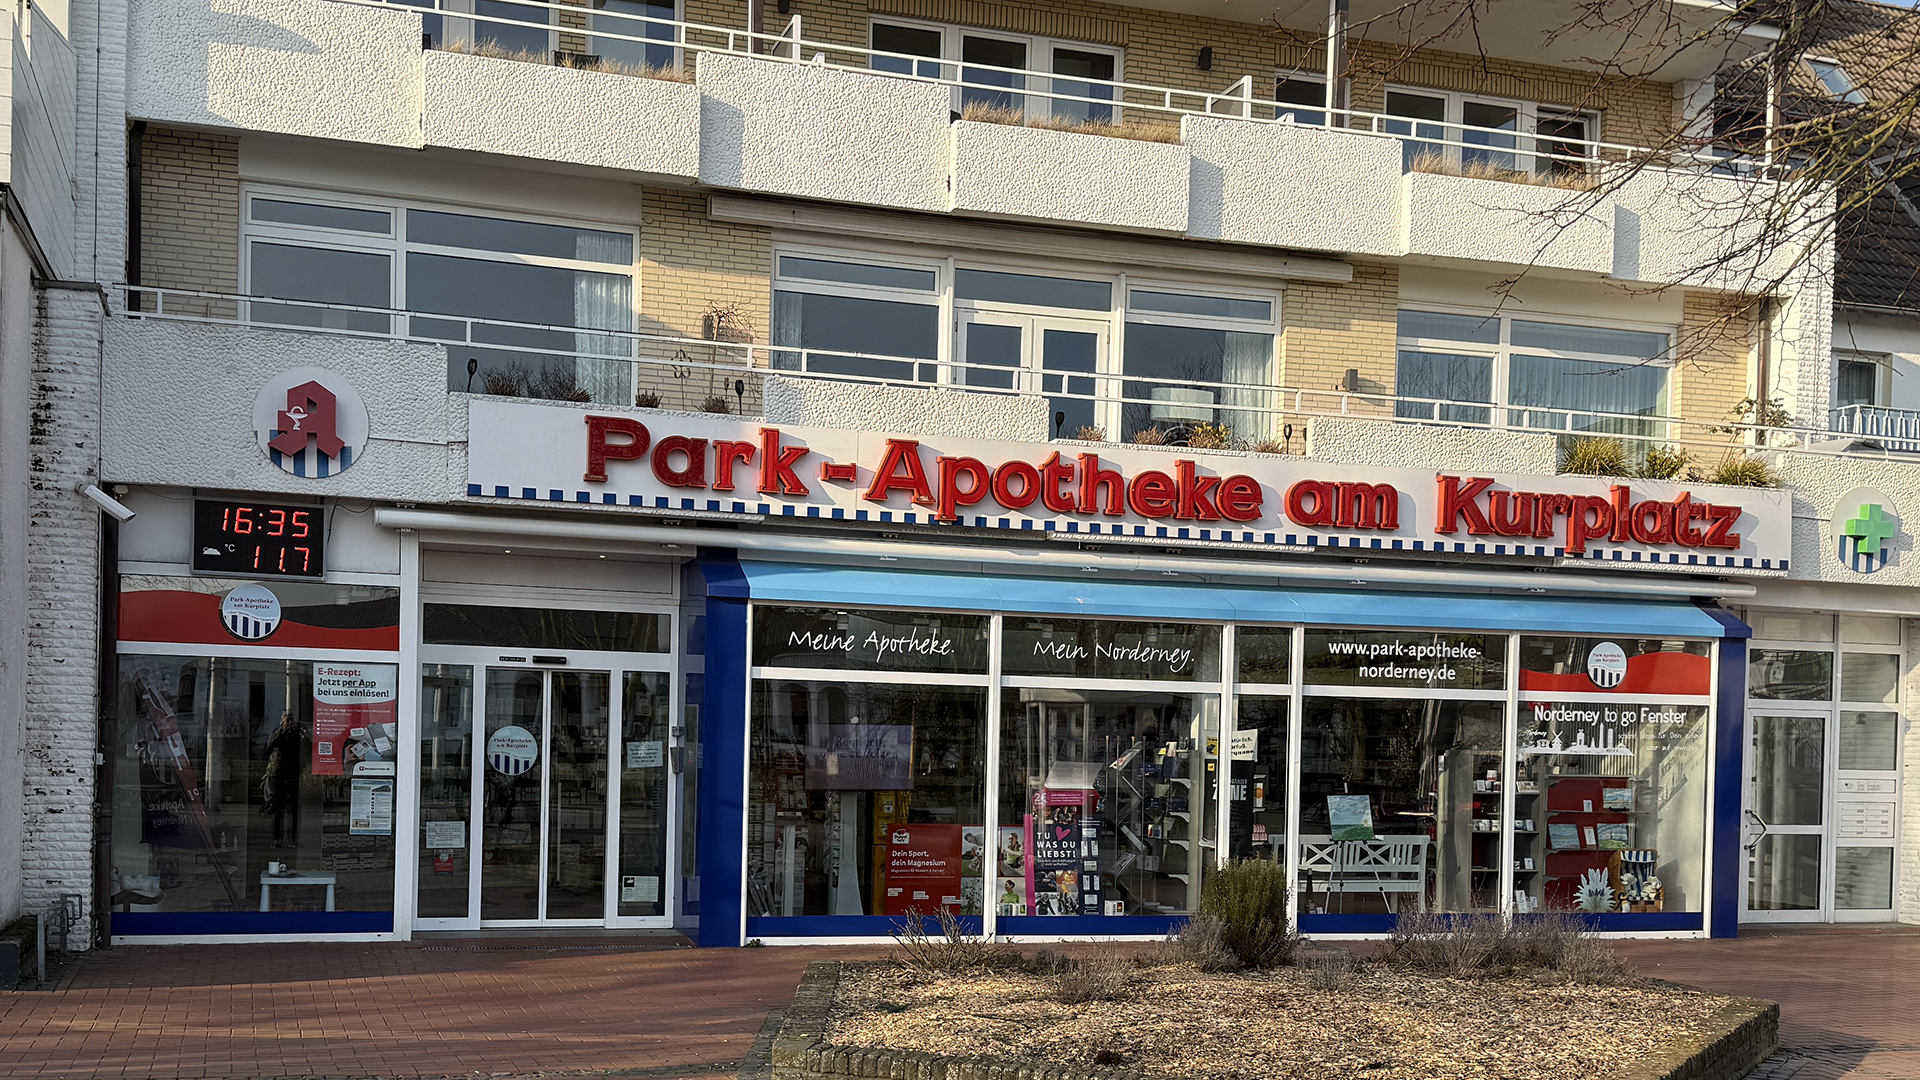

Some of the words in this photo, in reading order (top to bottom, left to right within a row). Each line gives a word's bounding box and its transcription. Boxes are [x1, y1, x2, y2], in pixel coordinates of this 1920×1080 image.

[1284, 480, 1400, 530] am
[1433, 473, 1742, 554] Kurplatz
[222, 507, 310, 538] 16:35
[253, 545, 310, 572] 11.7
[230, 596, 274, 604] Park-Apotheke
[788, 628, 855, 652] Meine
[863, 627, 955, 664] Apotheke.
[1328, 639, 1482, 662] www.park-apotheke-
[1033, 637, 1088, 660] Mein
[1094, 641, 1196, 672] Norderney.
[318, 667, 361, 677] E-Rezept:
[1359, 662, 1456, 683] norderney.de
[318, 678, 340, 686] Jetzt
[342, 680, 357, 688] per
[359, 679, 376, 688] App
[318, 688, 331, 696] bei
[349, 689, 389, 698] einlösen!
[1534, 705, 1600, 725] Norderney
[1604, 707, 1618, 722] to
[1621, 711, 1637, 727] go
[1640, 707, 1687, 724] Fenster
[1661, 743, 1671, 751] auf
[1037, 832, 1050, 840] TU
[1037, 850, 1076, 858] LIEBST!
[907, 860, 946, 868] Magnesium
